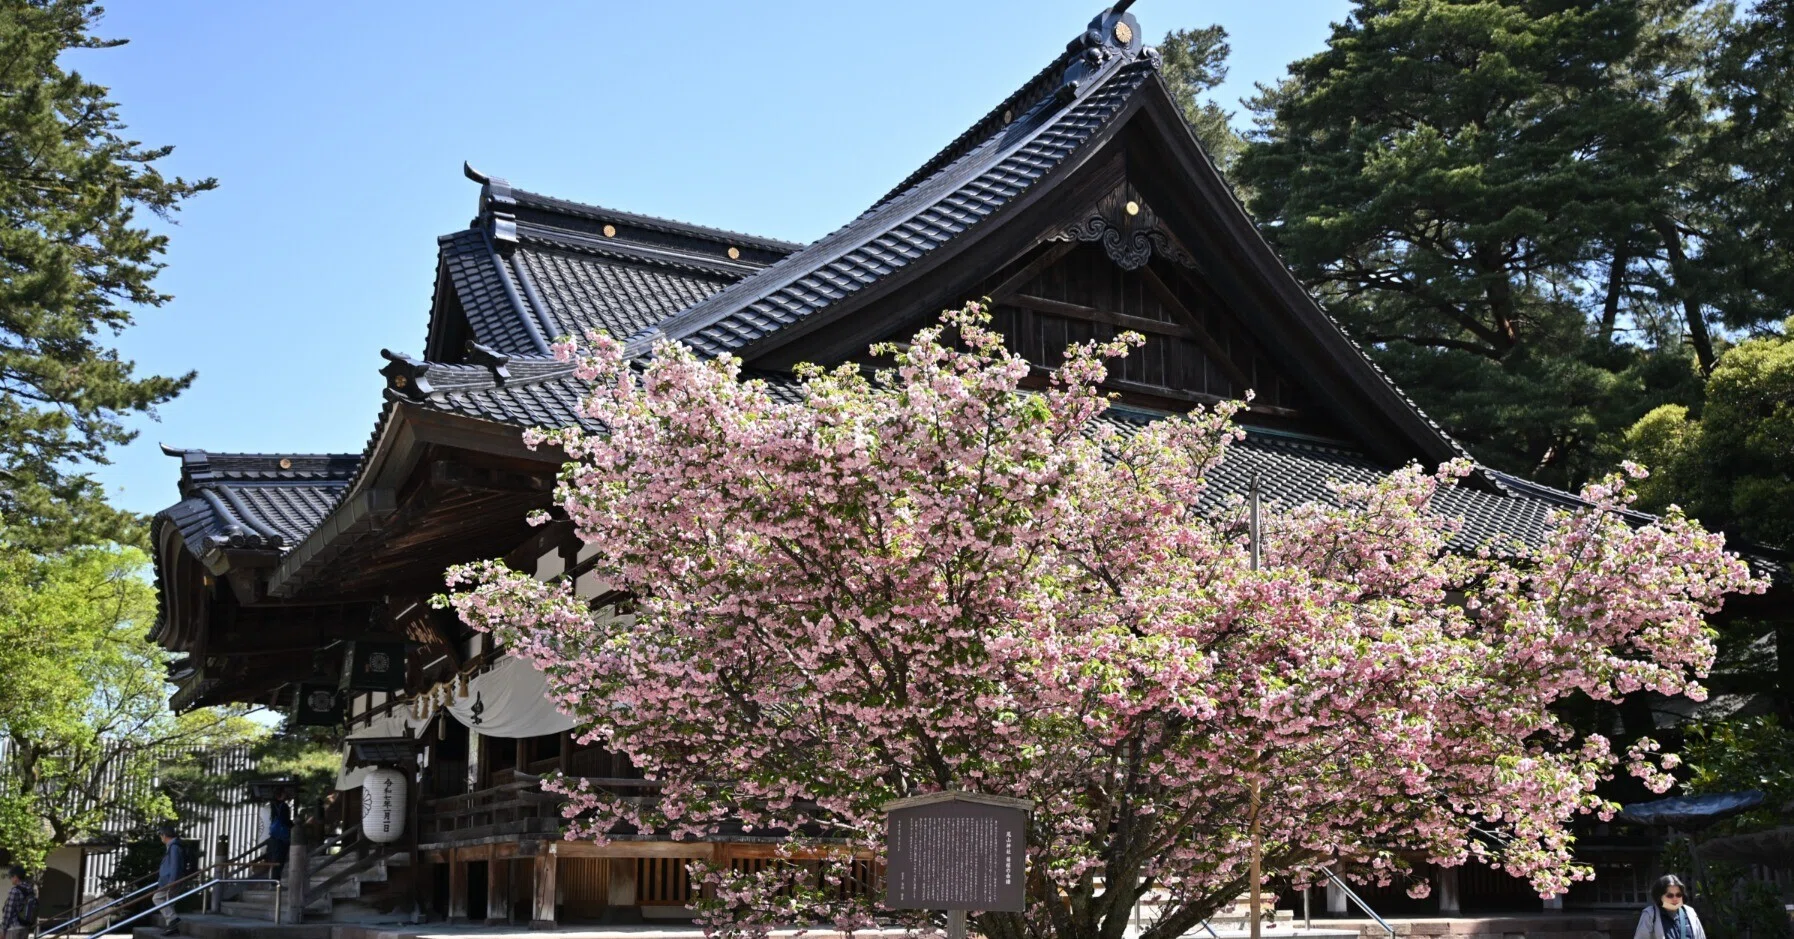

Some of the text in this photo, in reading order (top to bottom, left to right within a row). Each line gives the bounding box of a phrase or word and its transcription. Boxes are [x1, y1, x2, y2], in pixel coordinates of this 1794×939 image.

[383, 778, 394, 832] 令和七年一月一日
